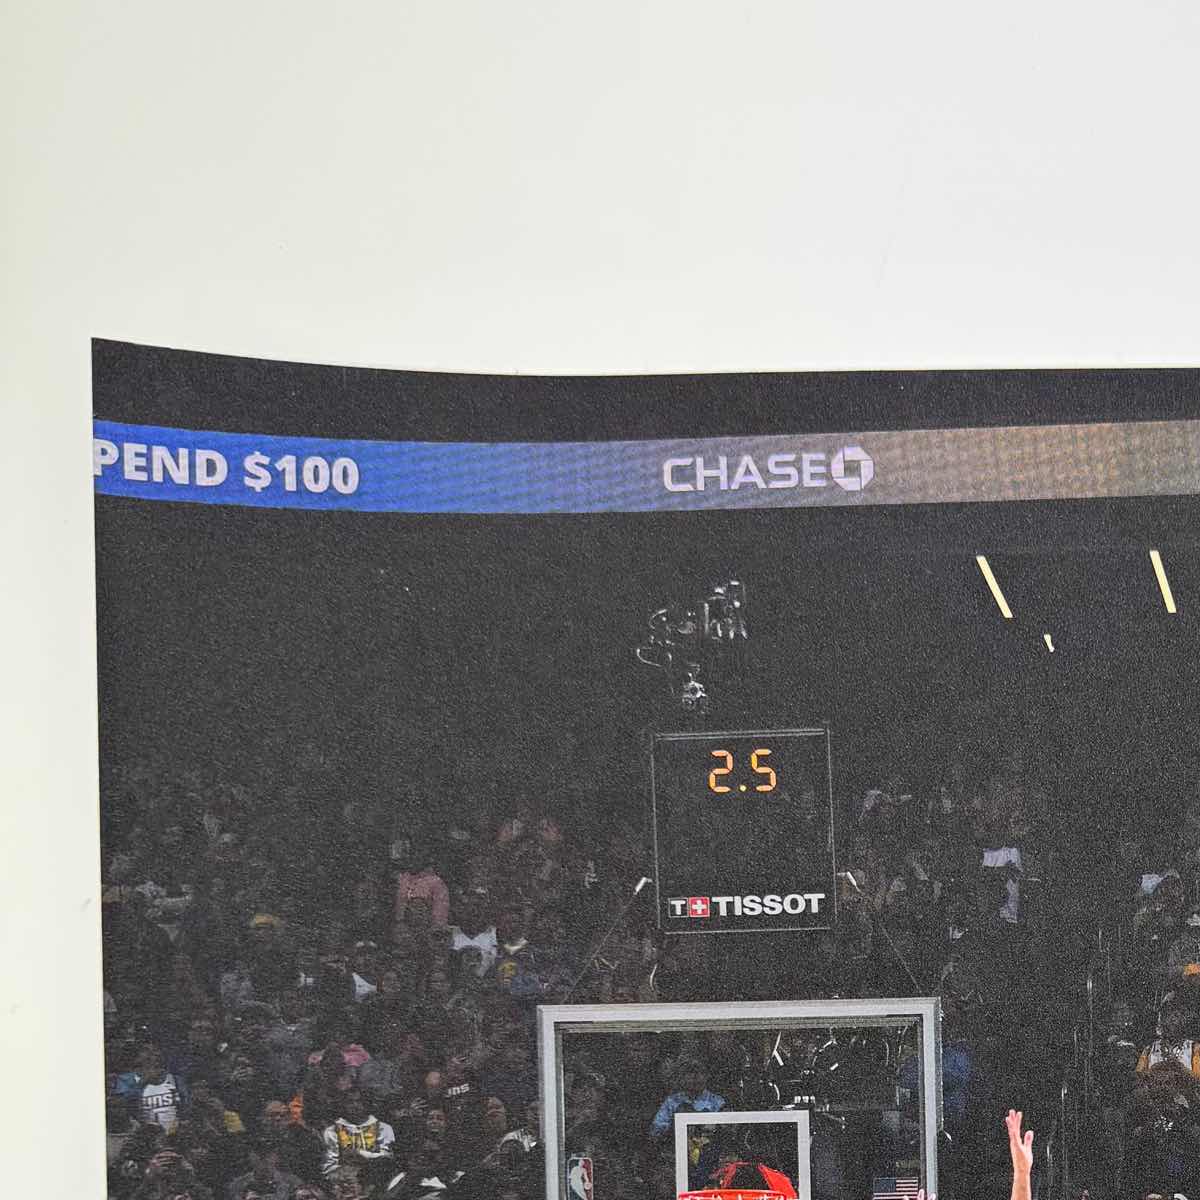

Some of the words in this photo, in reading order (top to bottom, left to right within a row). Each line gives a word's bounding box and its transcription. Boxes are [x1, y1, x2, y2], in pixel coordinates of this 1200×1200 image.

[243, 454, 360, 495] $100
[663, 453, 828, 493] CHASE
[708, 749, 777, 793] 2.5
[712, 893, 825, 916] TISSOT
